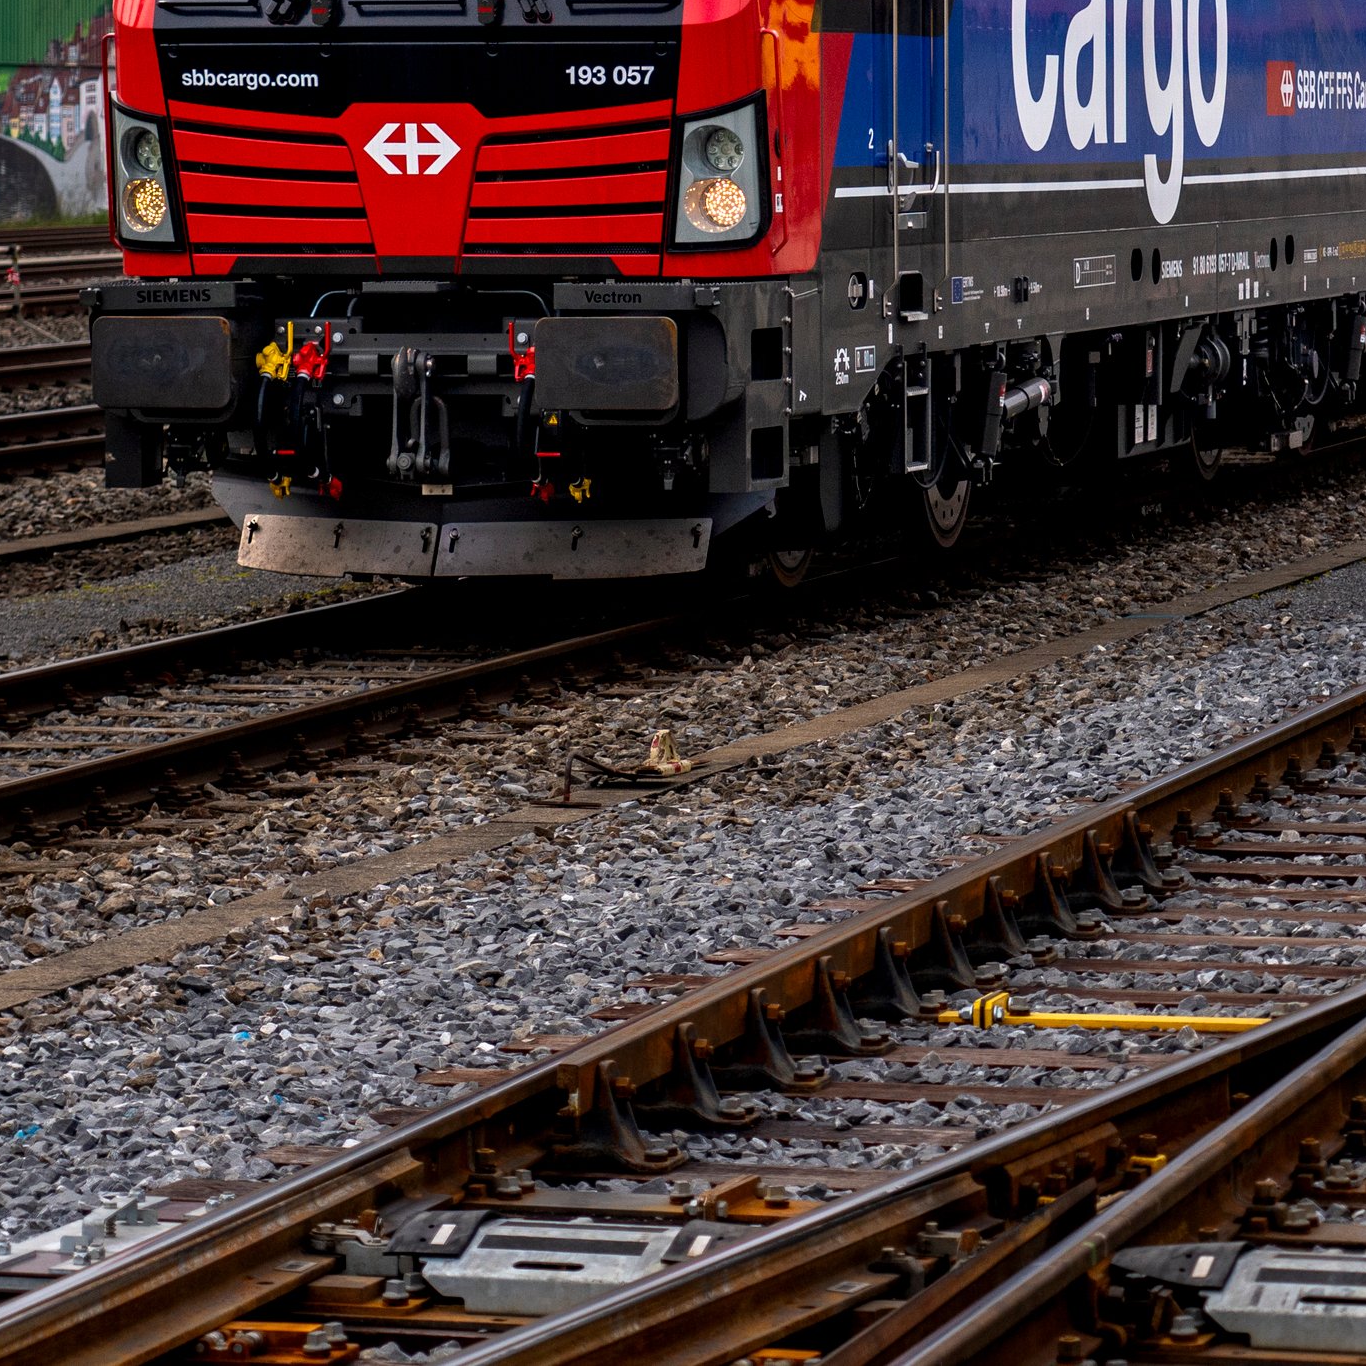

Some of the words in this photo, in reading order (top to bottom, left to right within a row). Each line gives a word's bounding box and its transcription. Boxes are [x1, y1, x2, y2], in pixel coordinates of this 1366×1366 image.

[182, 69, 319, 90] sbbcargo.com
[565, 66, 607, 85] 193
[613, 66, 655, 85] 057
[1297, 69, 1315, 109] SBB
[1317, 70, 1335, 110] CFF
[1336, 71, 1353, 110] FFS
[868, 128, 874, 150] 2
[1161, 259, 1183, 279] SIEMENS
[136, 288, 212, 304] SIEMENS
[584, 290, 642, 304] Vectron
[835, 372, 849, 386] 250m
